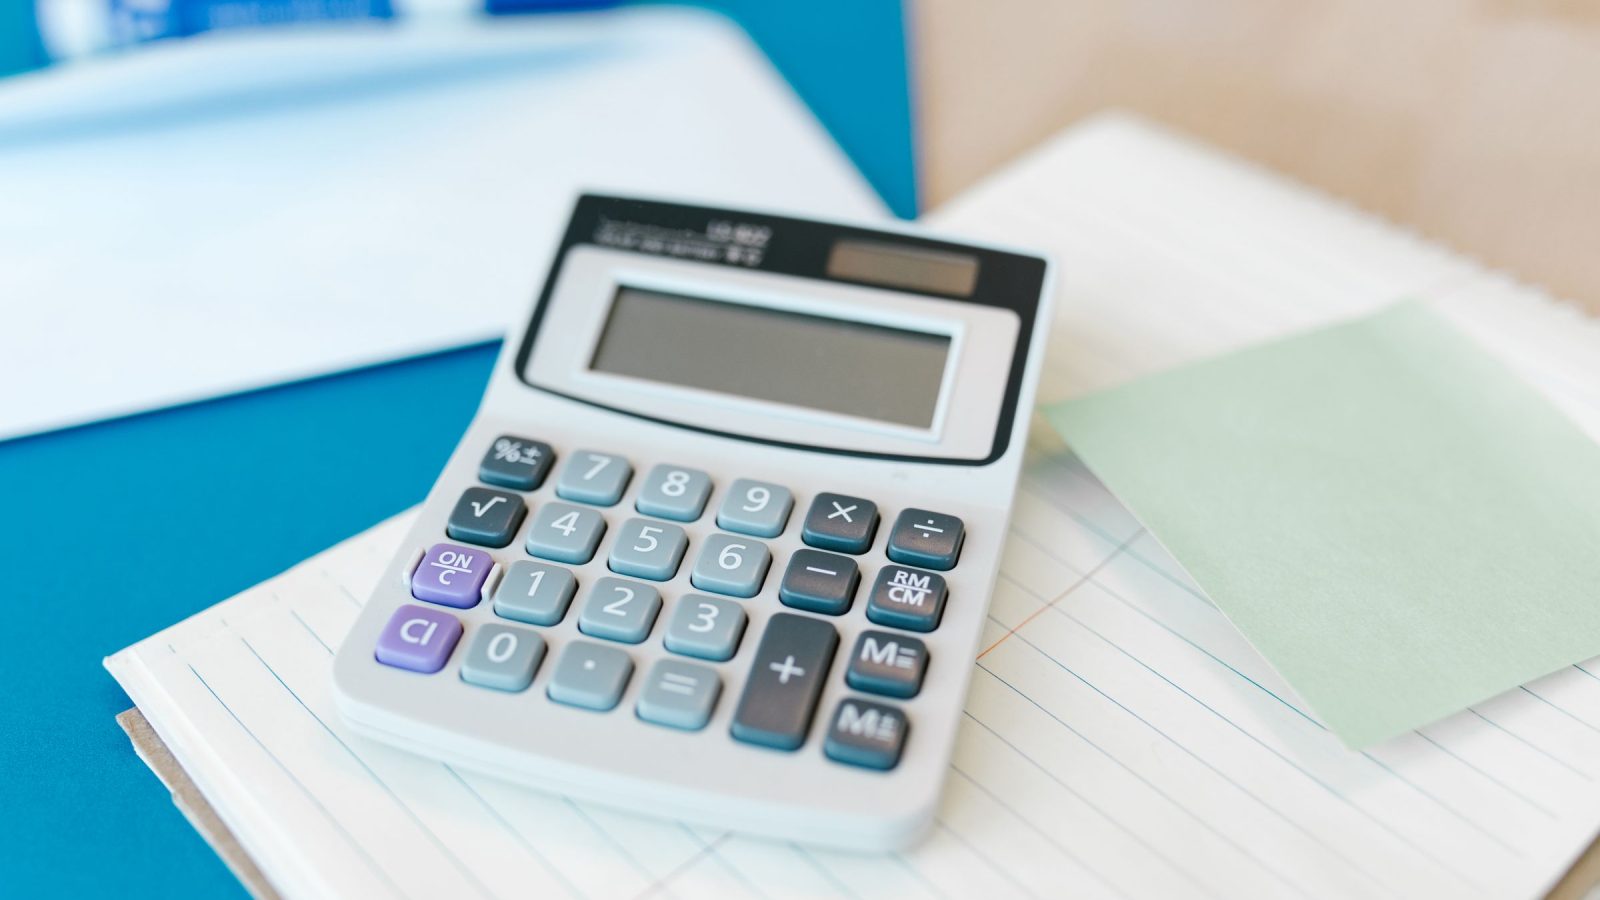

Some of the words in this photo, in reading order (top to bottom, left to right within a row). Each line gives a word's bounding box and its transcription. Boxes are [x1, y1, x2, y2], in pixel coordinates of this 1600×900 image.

[586, 455, 611, 480] 7
[661, 471, 690, 497] 8
[742, 486, 771, 513] 9
[551, 511, 580, 537] 4
[633, 526, 663, 552] 5
[438, 551, 473, 569] ON
[718, 543, 747, 570] 6
[438, 568, 456, 586] C
[528, 570, 545, 597] 1
[894, 570, 931, 588] RM
[603, 587, 634, 616] 2
[888, 587, 926, 607] CM
[688, 604, 719, 633] 3
[487, 632, 517, 663] 0
